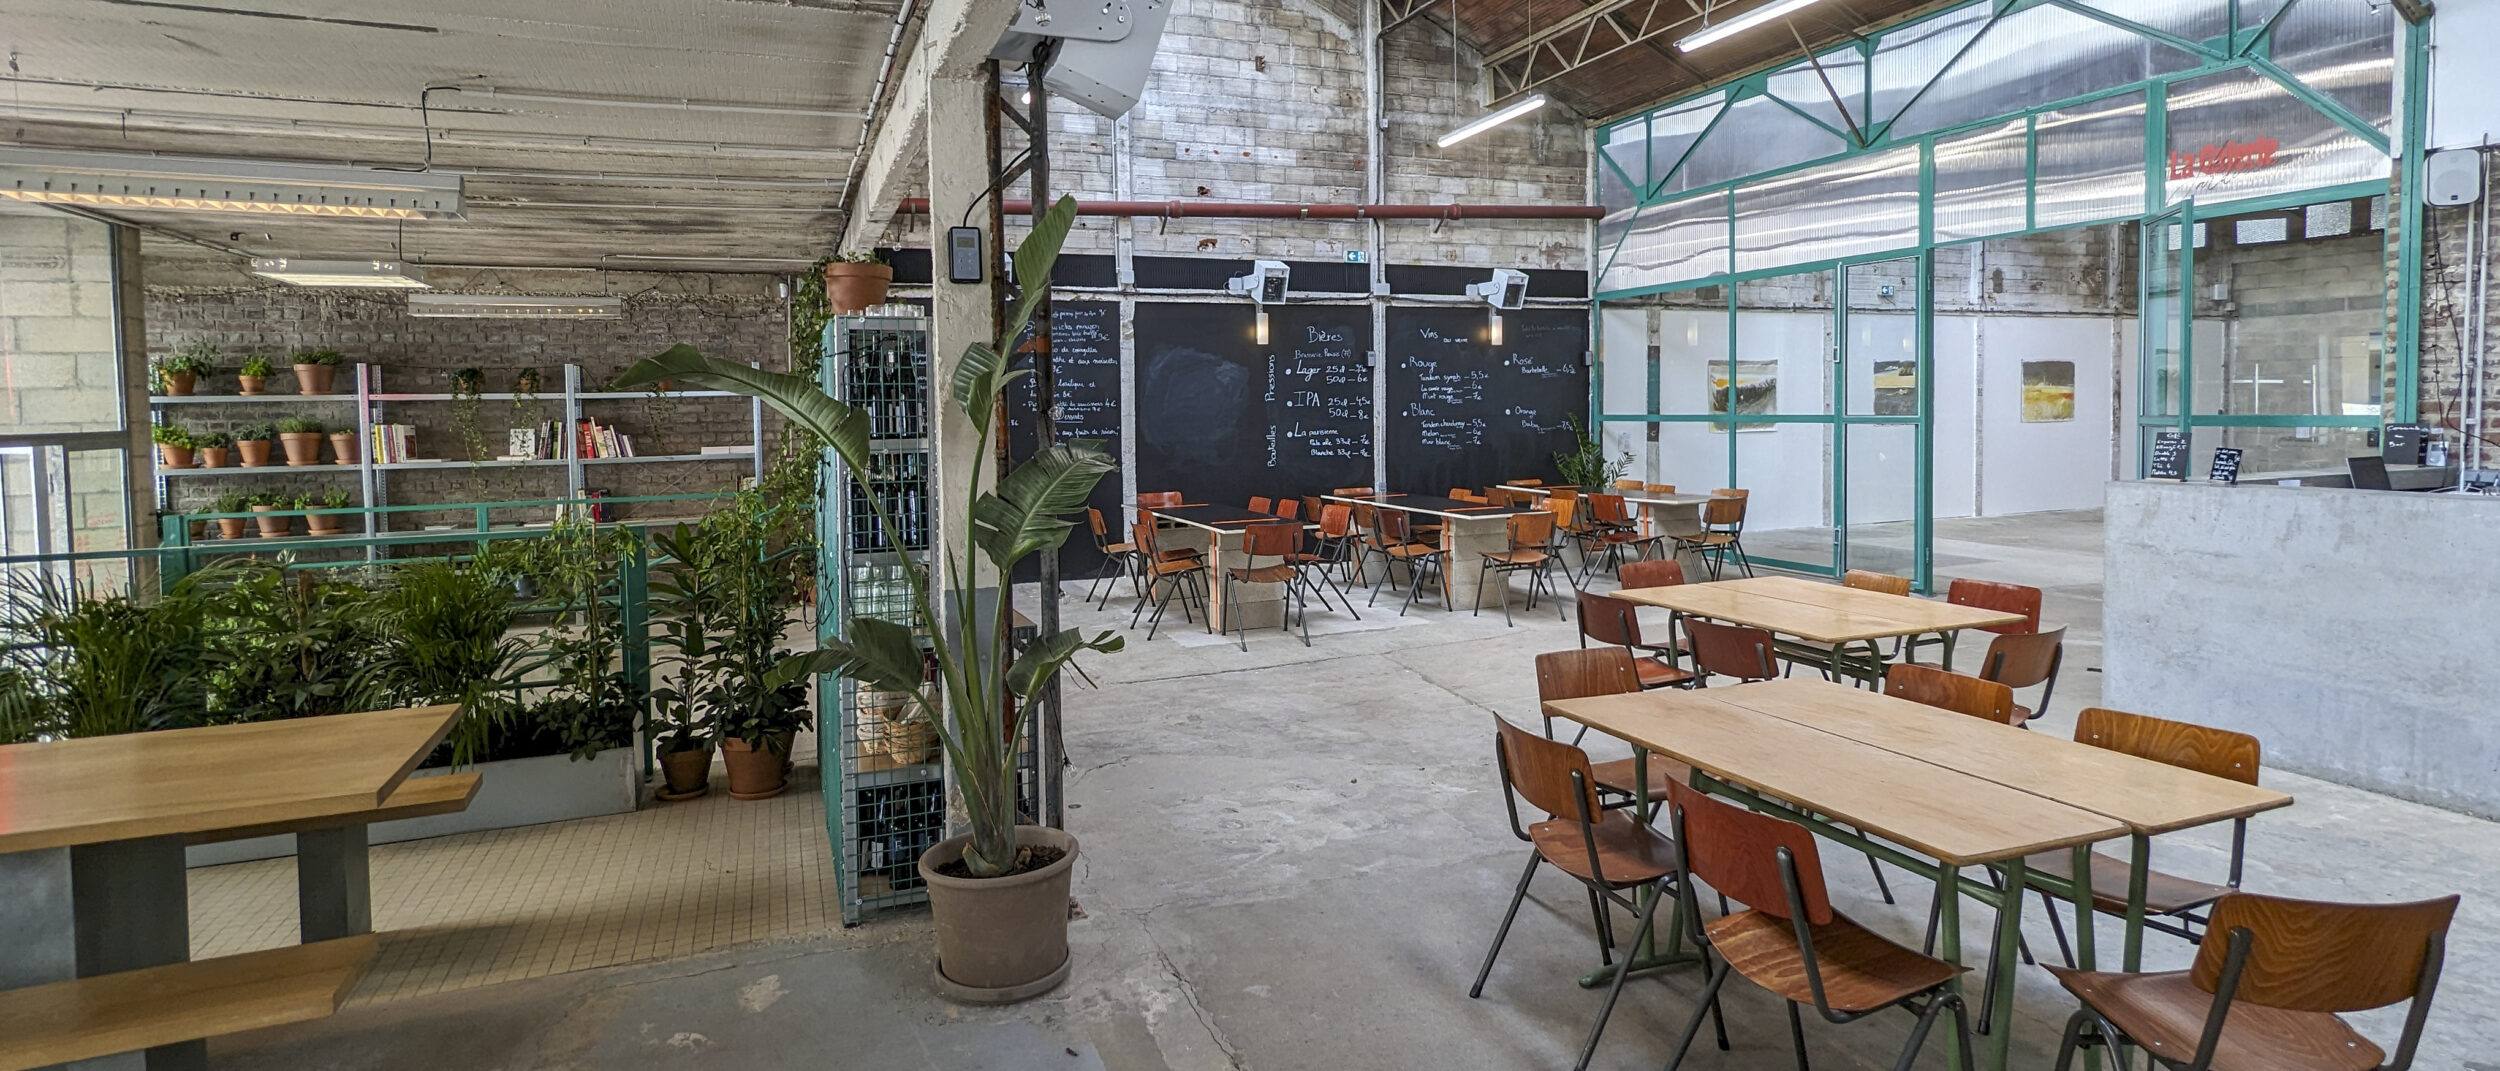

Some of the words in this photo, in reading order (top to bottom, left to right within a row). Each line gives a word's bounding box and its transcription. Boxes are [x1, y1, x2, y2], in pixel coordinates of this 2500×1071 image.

[1306, 325, 1344, 344] Bières
[1420, 327, 1440, 340] Vins
[1409, 355, 1438, 376] Rouge
[1512, 352, 1534, 366] Rosé
[1264, 354, 1276, 402] Pressions
[1296, 359, 1322, 382] Lager
[1293, 390, 1321, 408] IPA
[1410, 402, 1436, 417] Blanc
[1515, 405, 1538, 419] Orange
[1294, 421, 1307, 438] La
[1265, 424, 1278, 467] Bouteilles
